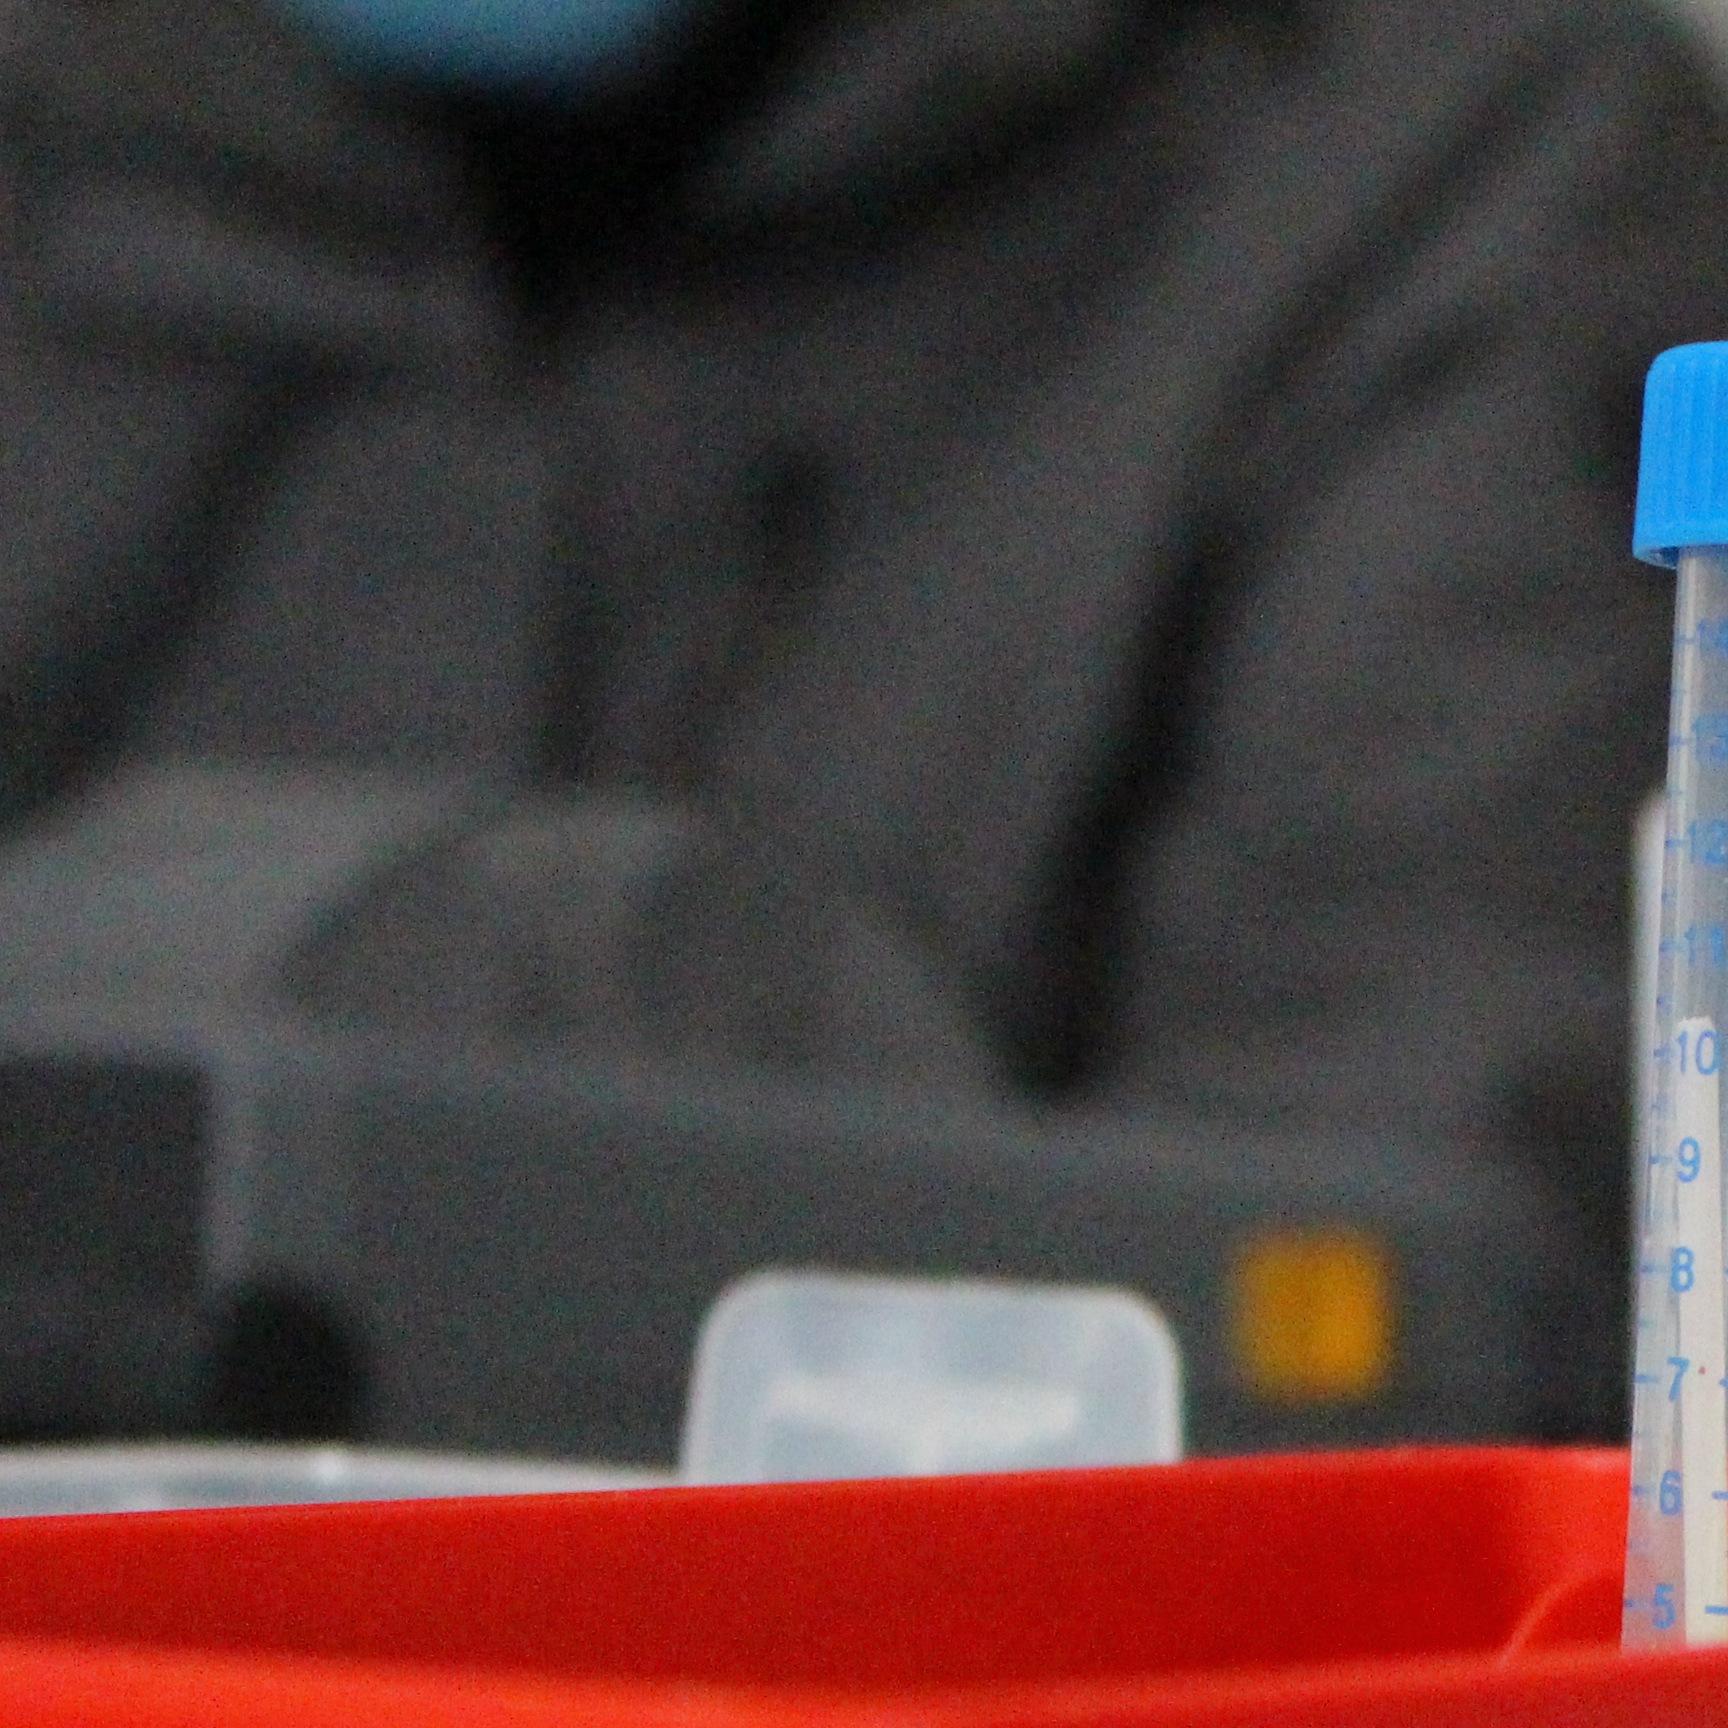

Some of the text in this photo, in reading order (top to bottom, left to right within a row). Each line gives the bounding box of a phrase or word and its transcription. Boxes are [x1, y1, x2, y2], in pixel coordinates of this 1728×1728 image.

[1676, 1030, 1721, 1076] 10
[1676, 1136, 1701, 1183] 9
[1669, 1246, 1694, 1293] 8
[1667, 1356, 1690, 1401] 7
[1659, 1470, 1683, 1516] 6
[1653, 1583, 1676, 1629] 5
